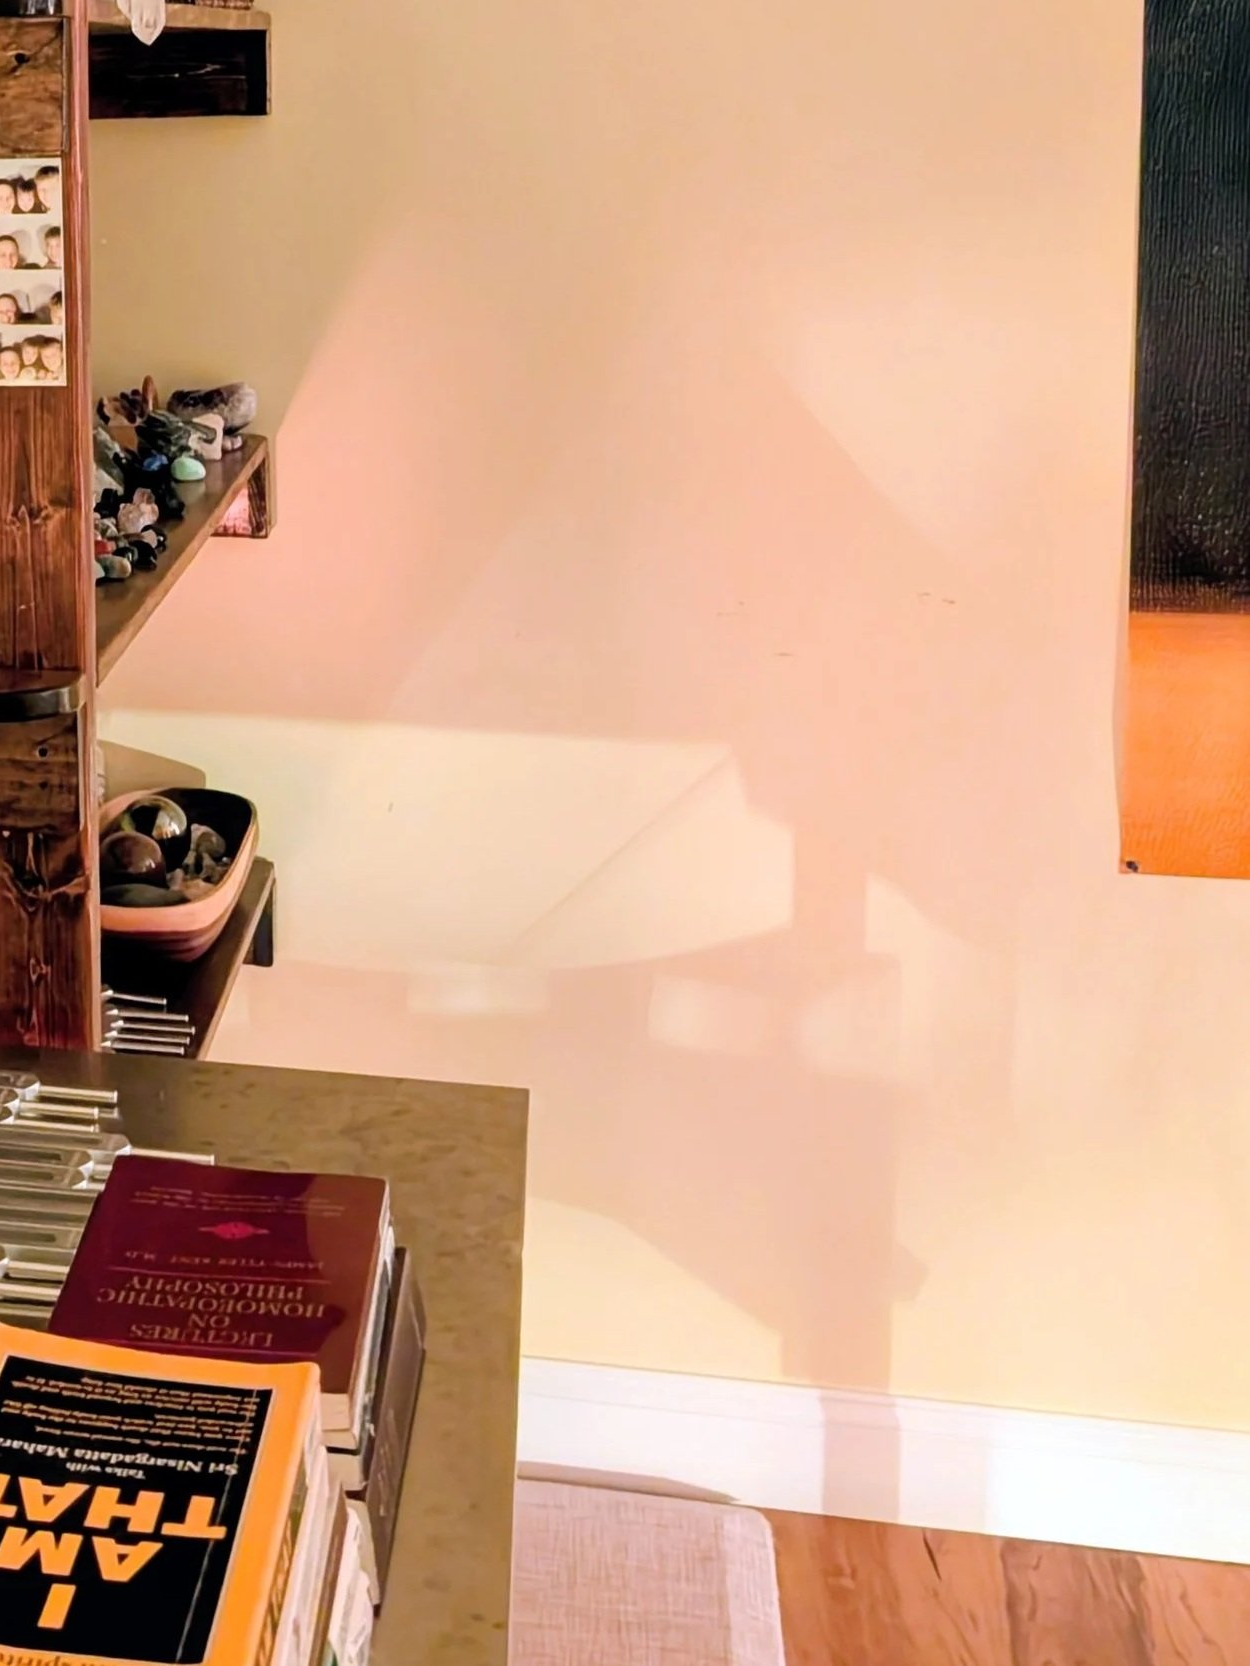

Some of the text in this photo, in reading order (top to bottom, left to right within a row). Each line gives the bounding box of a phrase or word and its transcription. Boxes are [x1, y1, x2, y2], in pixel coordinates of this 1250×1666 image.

[126, 1275, 304, 1300] PHILOSOPHY
[97, 1287, 325, 1318] HOMOEOPATHIC
[188, 1313, 231, 1329] ON
[130, 1323, 273, 1347] LECTURES
[66, 1461, 147, 1479] Talks with
[74, 1449, 203, 1473] Nisargadatta
[208, 1461, 240, 1476] Sri
[37, 1583, 77, 1630] I
